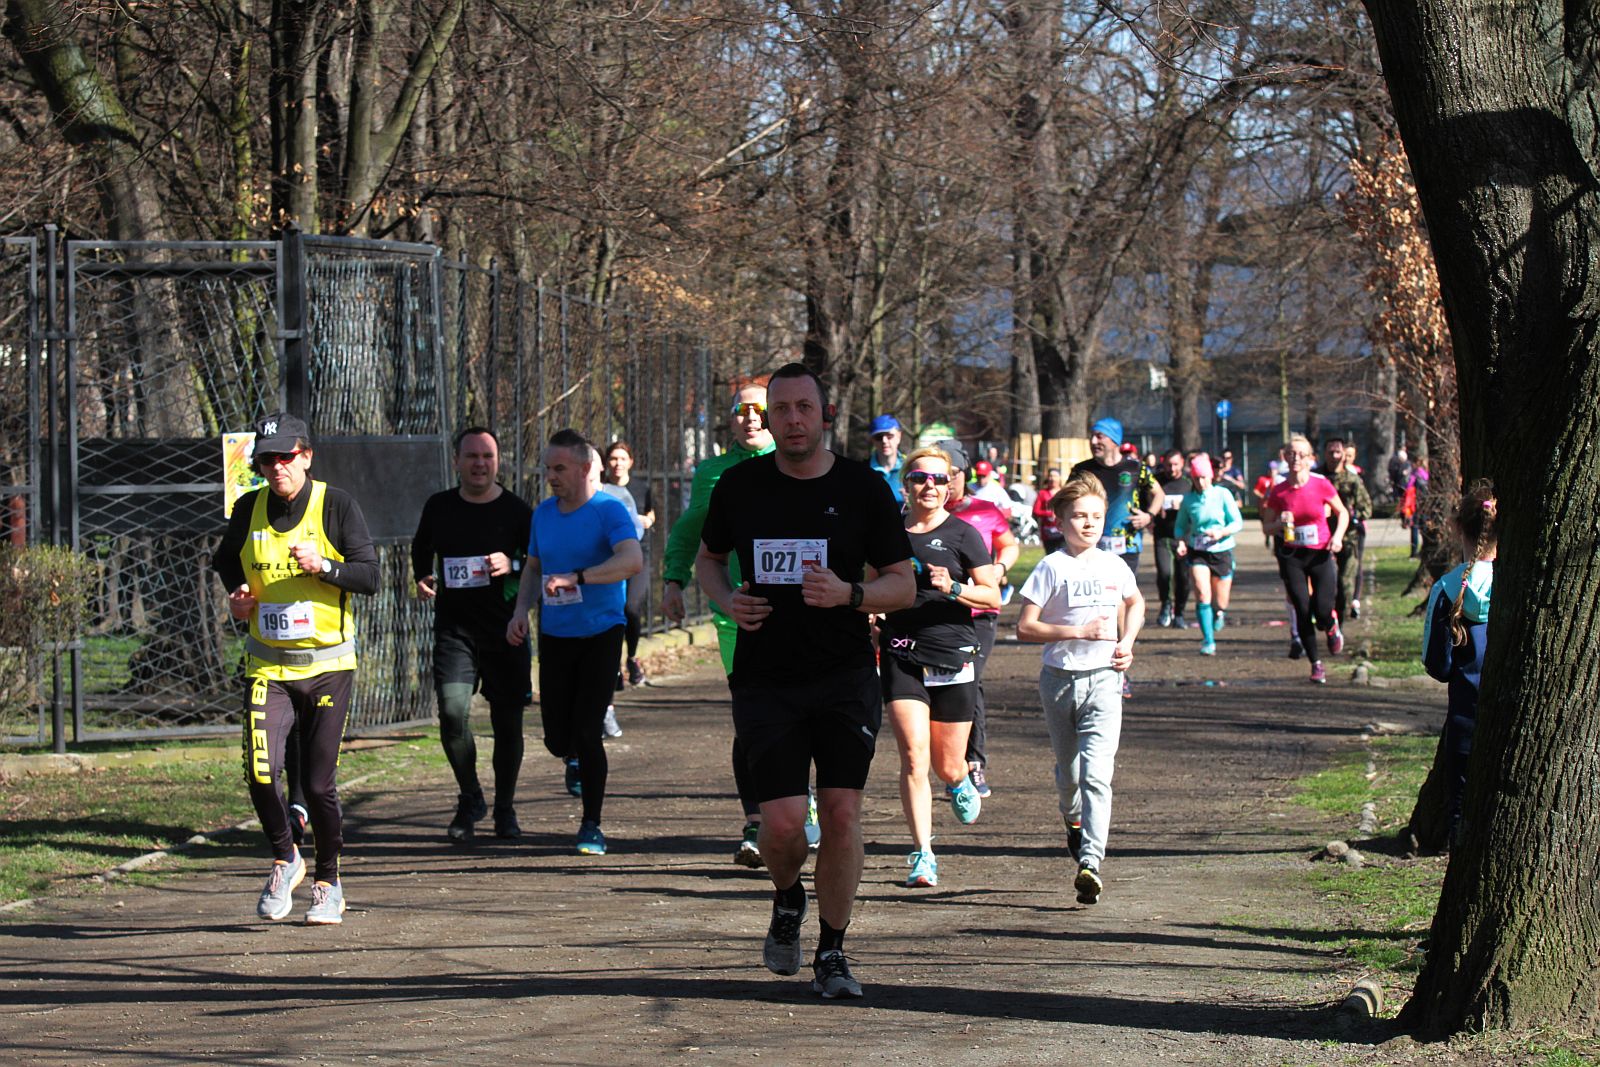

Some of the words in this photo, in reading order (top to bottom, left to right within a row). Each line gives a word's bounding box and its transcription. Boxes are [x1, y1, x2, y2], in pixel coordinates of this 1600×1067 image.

[251, 562, 270, 570] KB
[761, 551, 797, 573] 027
[448, 565, 468, 580] 123
[1072, 579, 1102, 597] 205
[262, 613, 289, 631] 196
[250, 711, 272, 784] LEW
